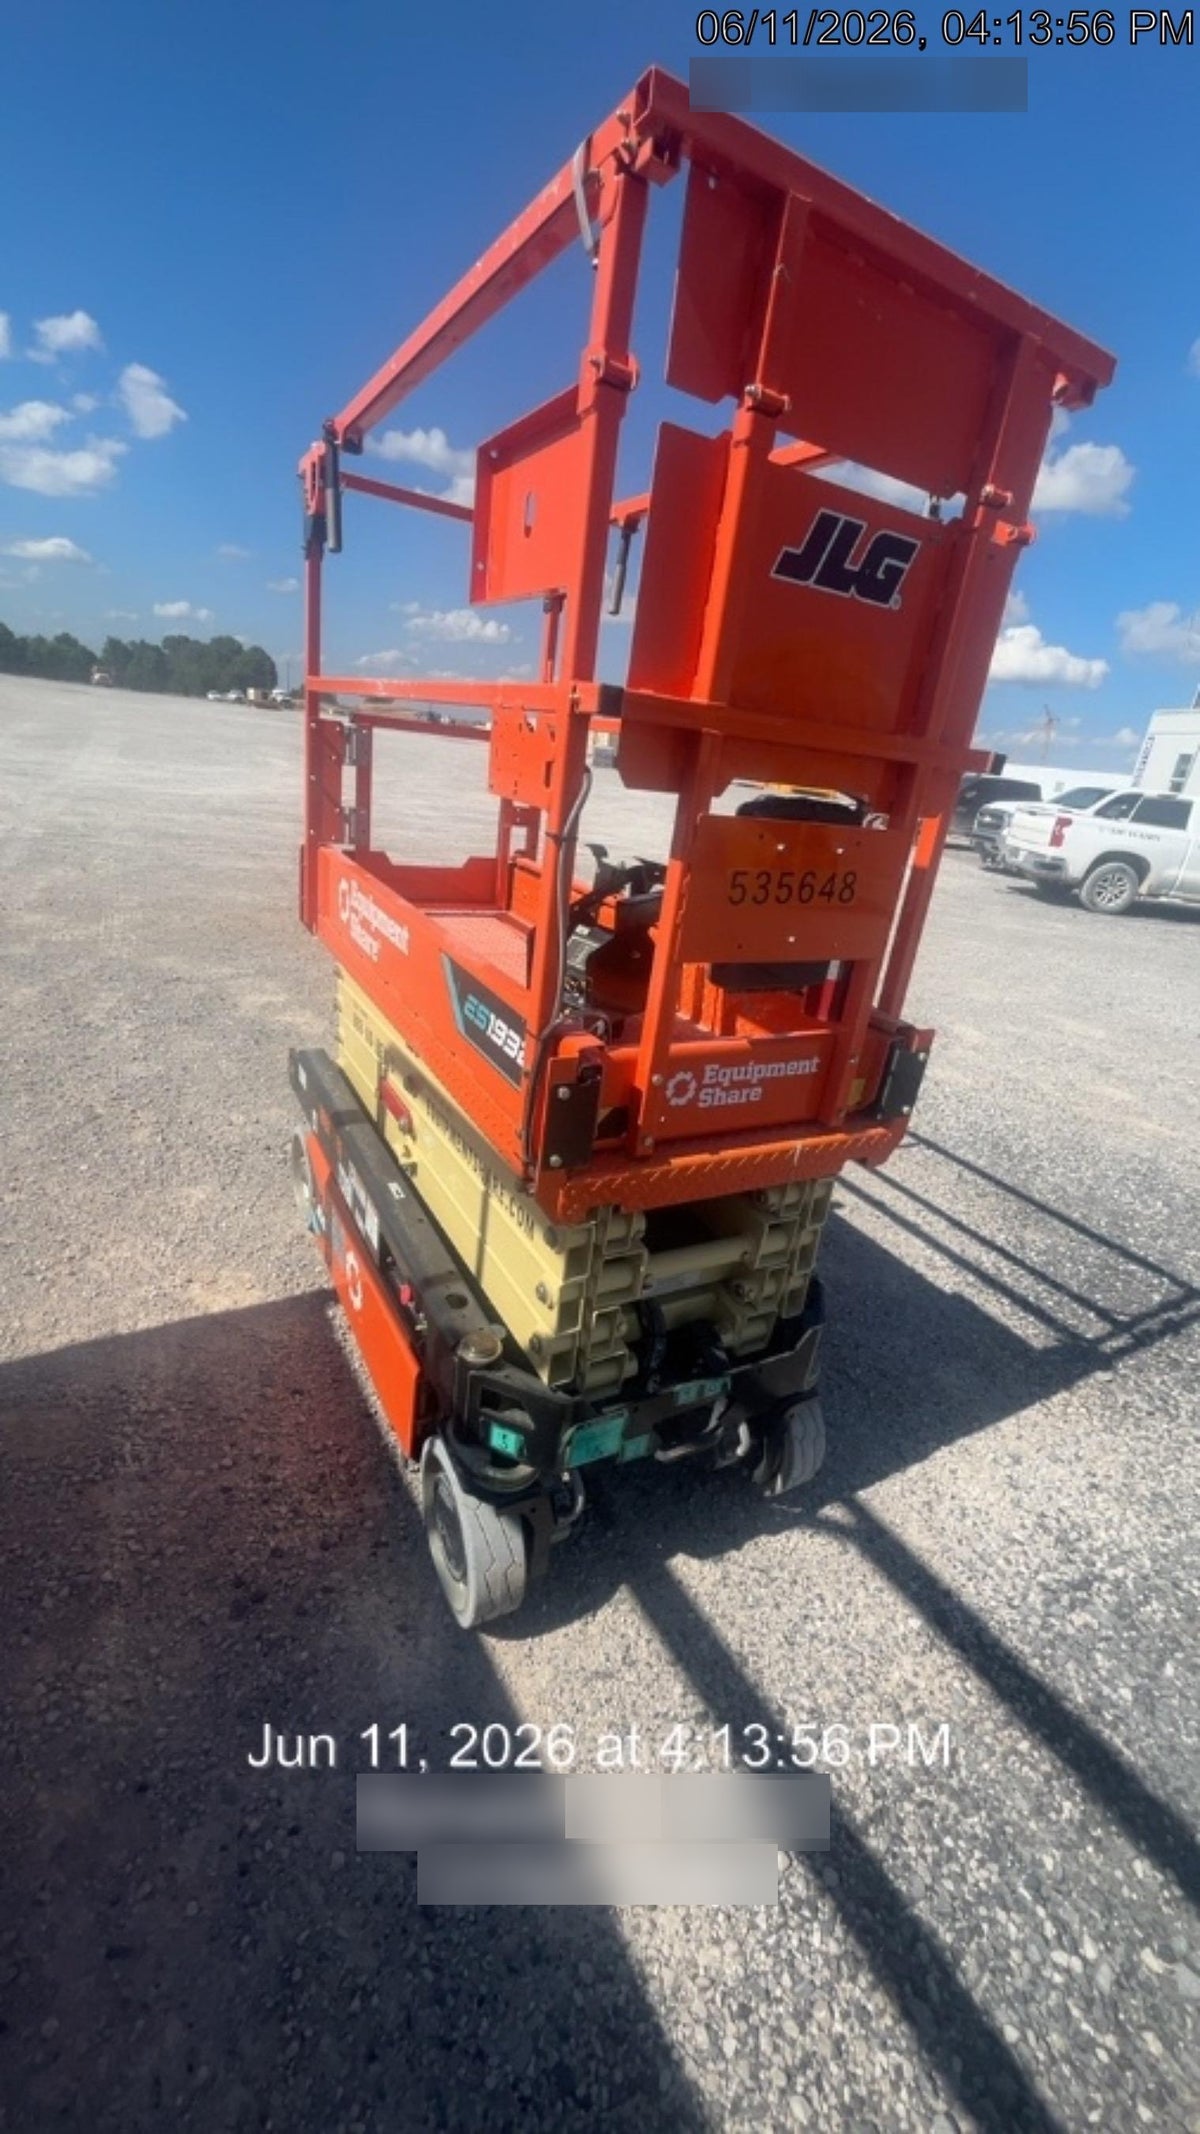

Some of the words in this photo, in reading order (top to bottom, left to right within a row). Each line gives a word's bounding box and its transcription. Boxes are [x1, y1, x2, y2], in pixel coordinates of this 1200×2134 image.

[770, 507, 921, 608] JLG
[728, 870, 857, 906] 535648
[702, 1056, 821, 1087] Equipment
[698, 1087, 763, 1108] Share
